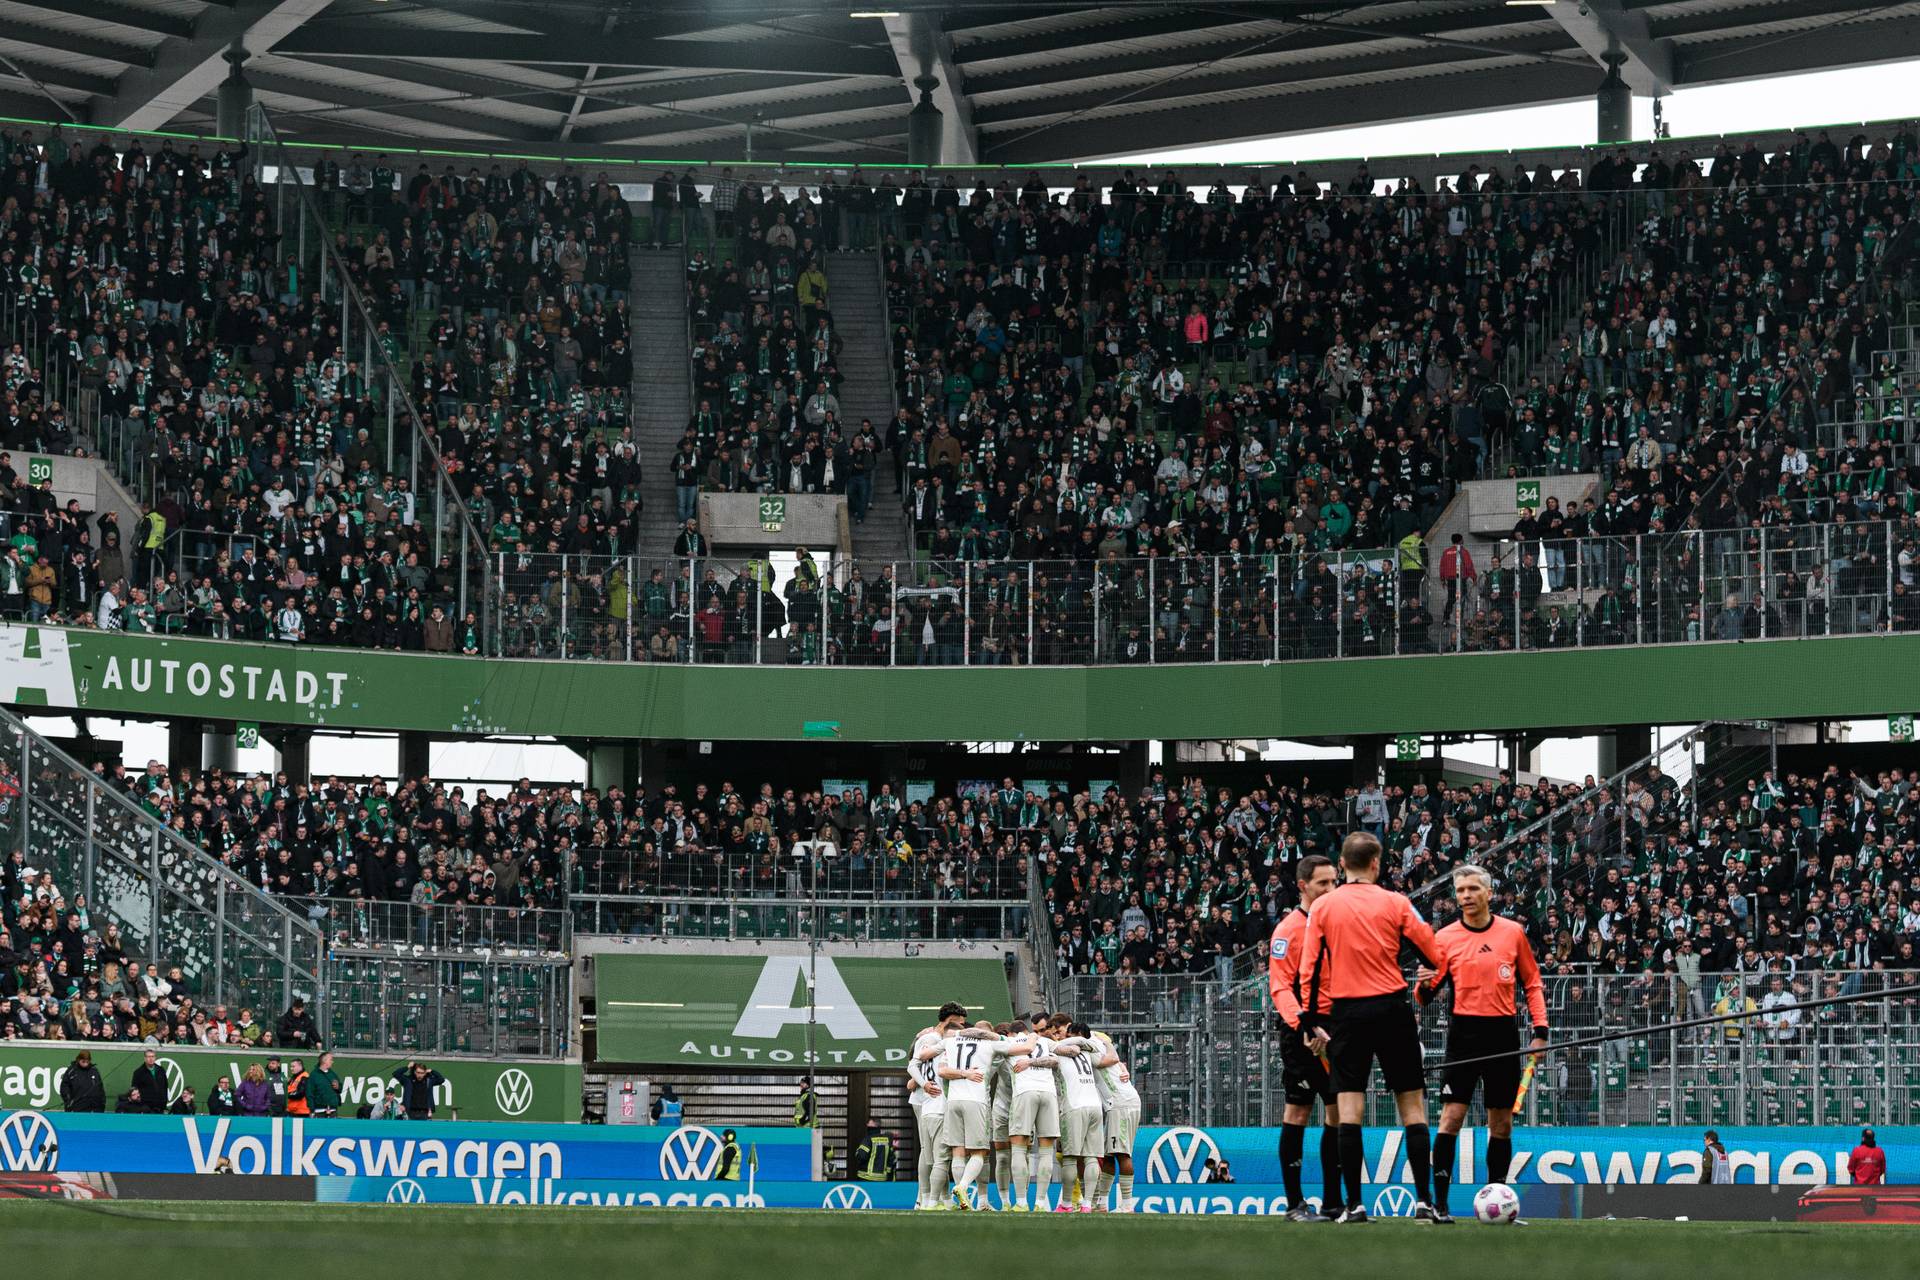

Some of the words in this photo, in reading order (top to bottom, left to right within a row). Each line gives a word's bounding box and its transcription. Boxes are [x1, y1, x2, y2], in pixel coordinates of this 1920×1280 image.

[30, 463, 51, 480] 30
[1517, 488, 1538, 502] 34
[761, 501, 783, 516] 32
[102, 655, 348, 706] AUTOSTADT
[238, 727, 258, 743] 29
[1890, 721, 1912, 736] 35
[1398, 739, 1419, 754] 33
[680, 1041, 908, 1064] AUTOSTAD
[956, 1042, 978, 1071] 17
[1071, 1051, 1092, 1075] 18
[183, 1117, 563, 1179] Volkswagen
[1111, 1136, 1117, 1149] 7
